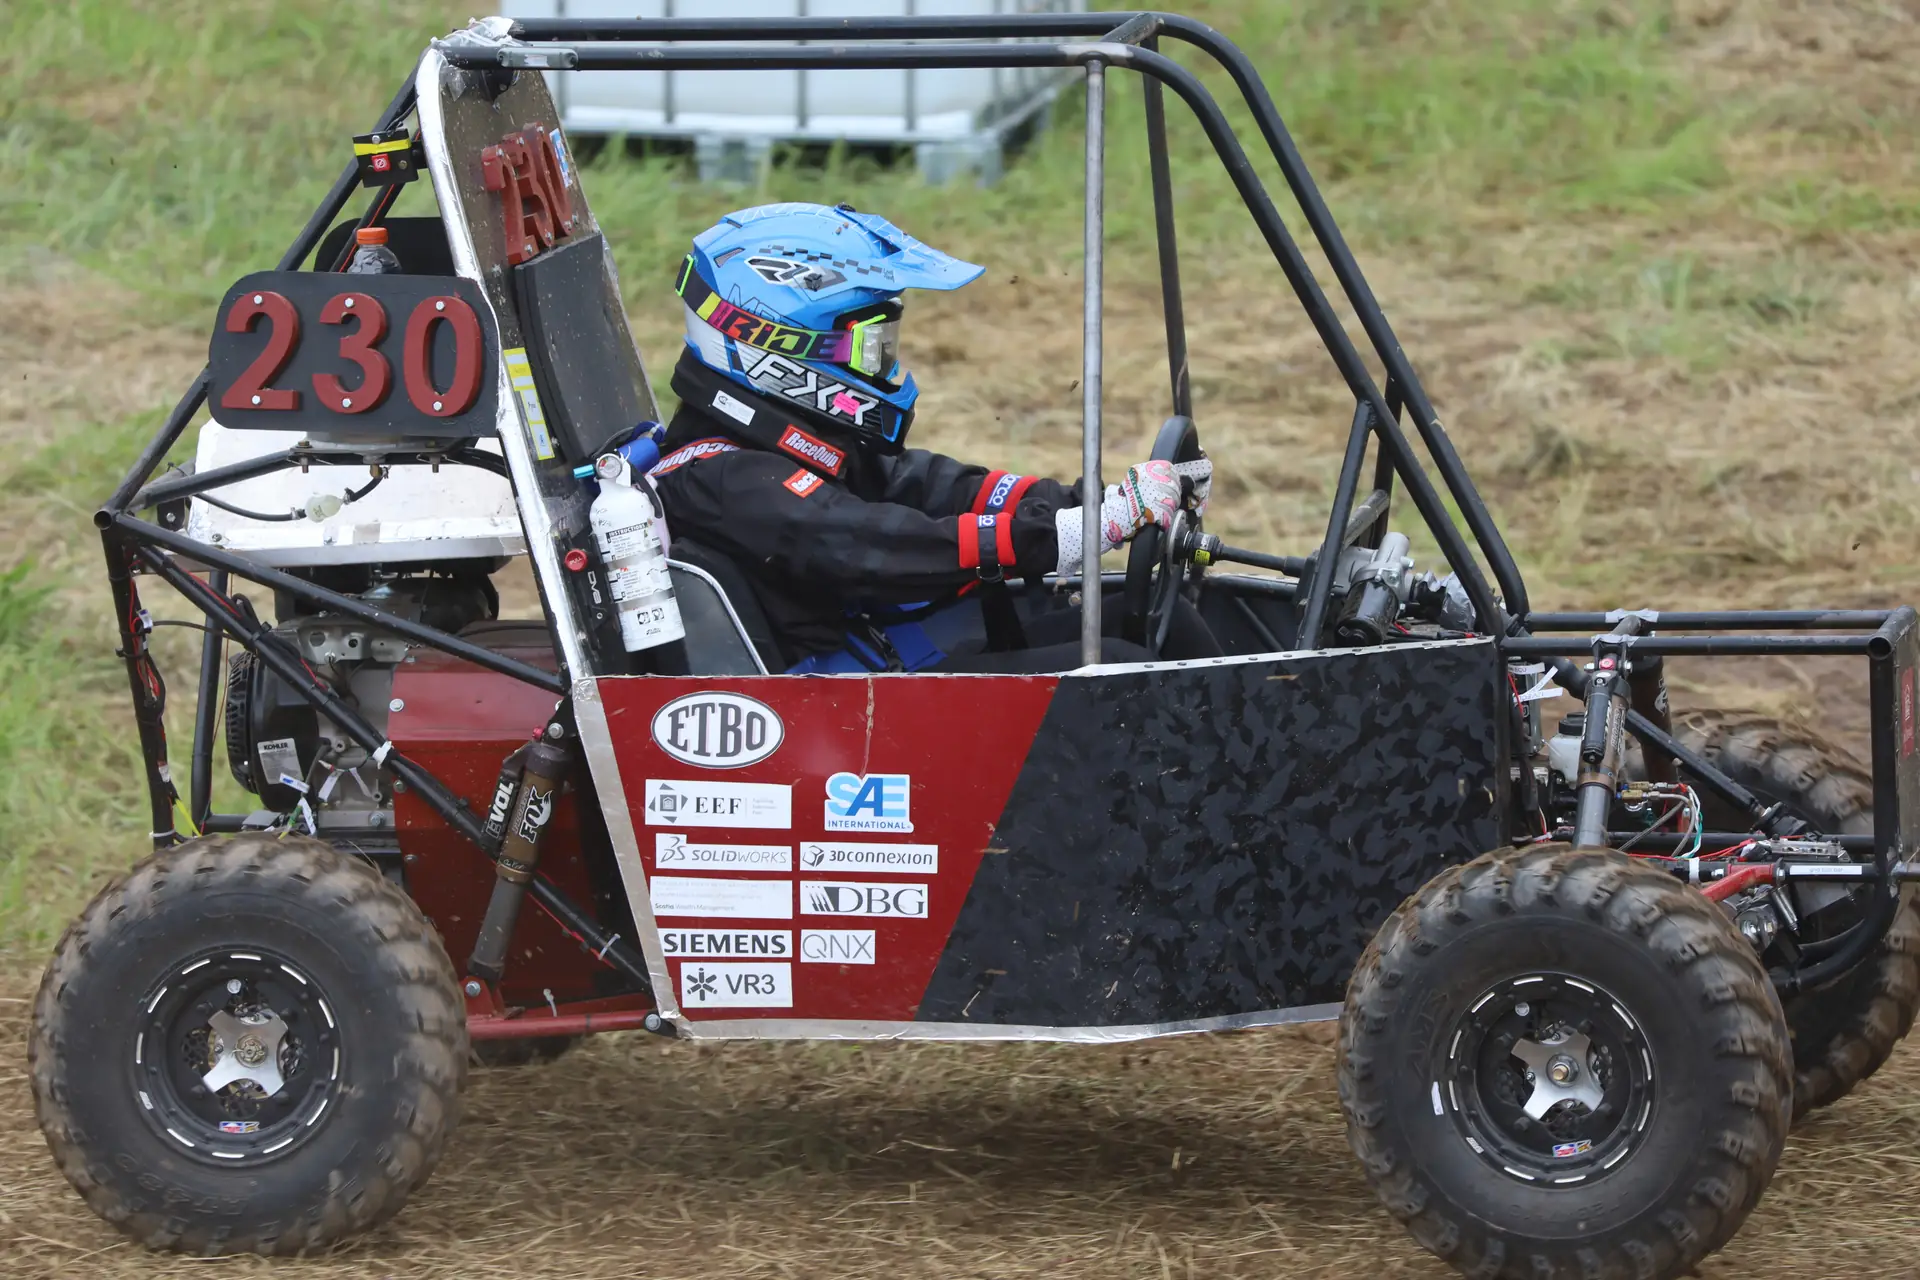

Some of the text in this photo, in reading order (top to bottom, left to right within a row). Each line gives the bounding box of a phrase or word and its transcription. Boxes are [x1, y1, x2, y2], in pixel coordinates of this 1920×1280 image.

[221, 290, 483, 417] 230
[747, 354, 879, 427] FXR
[785, 431, 840, 468] RaceQuip
[608, 523, 646, 538] INSTRUCTIONS
[667, 702, 767, 758] ETBO
[262, 742, 289, 752] KOHLER
[485, 781, 515, 839] EVOL
[695, 796, 742, 815] EEF
[828, 777, 907, 818] SAE
[519, 785, 553, 844] FOX
[828, 820, 905, 830] INTERNATIONAL
[692, 849, 788, 865] SOLIDWORKS
[832, 886, 925, 916] DBG
[663, 932, 786, 955] SIEMENS
[802, 934, 873, 960] QNX
[725, 973, 776, 995] VR3
